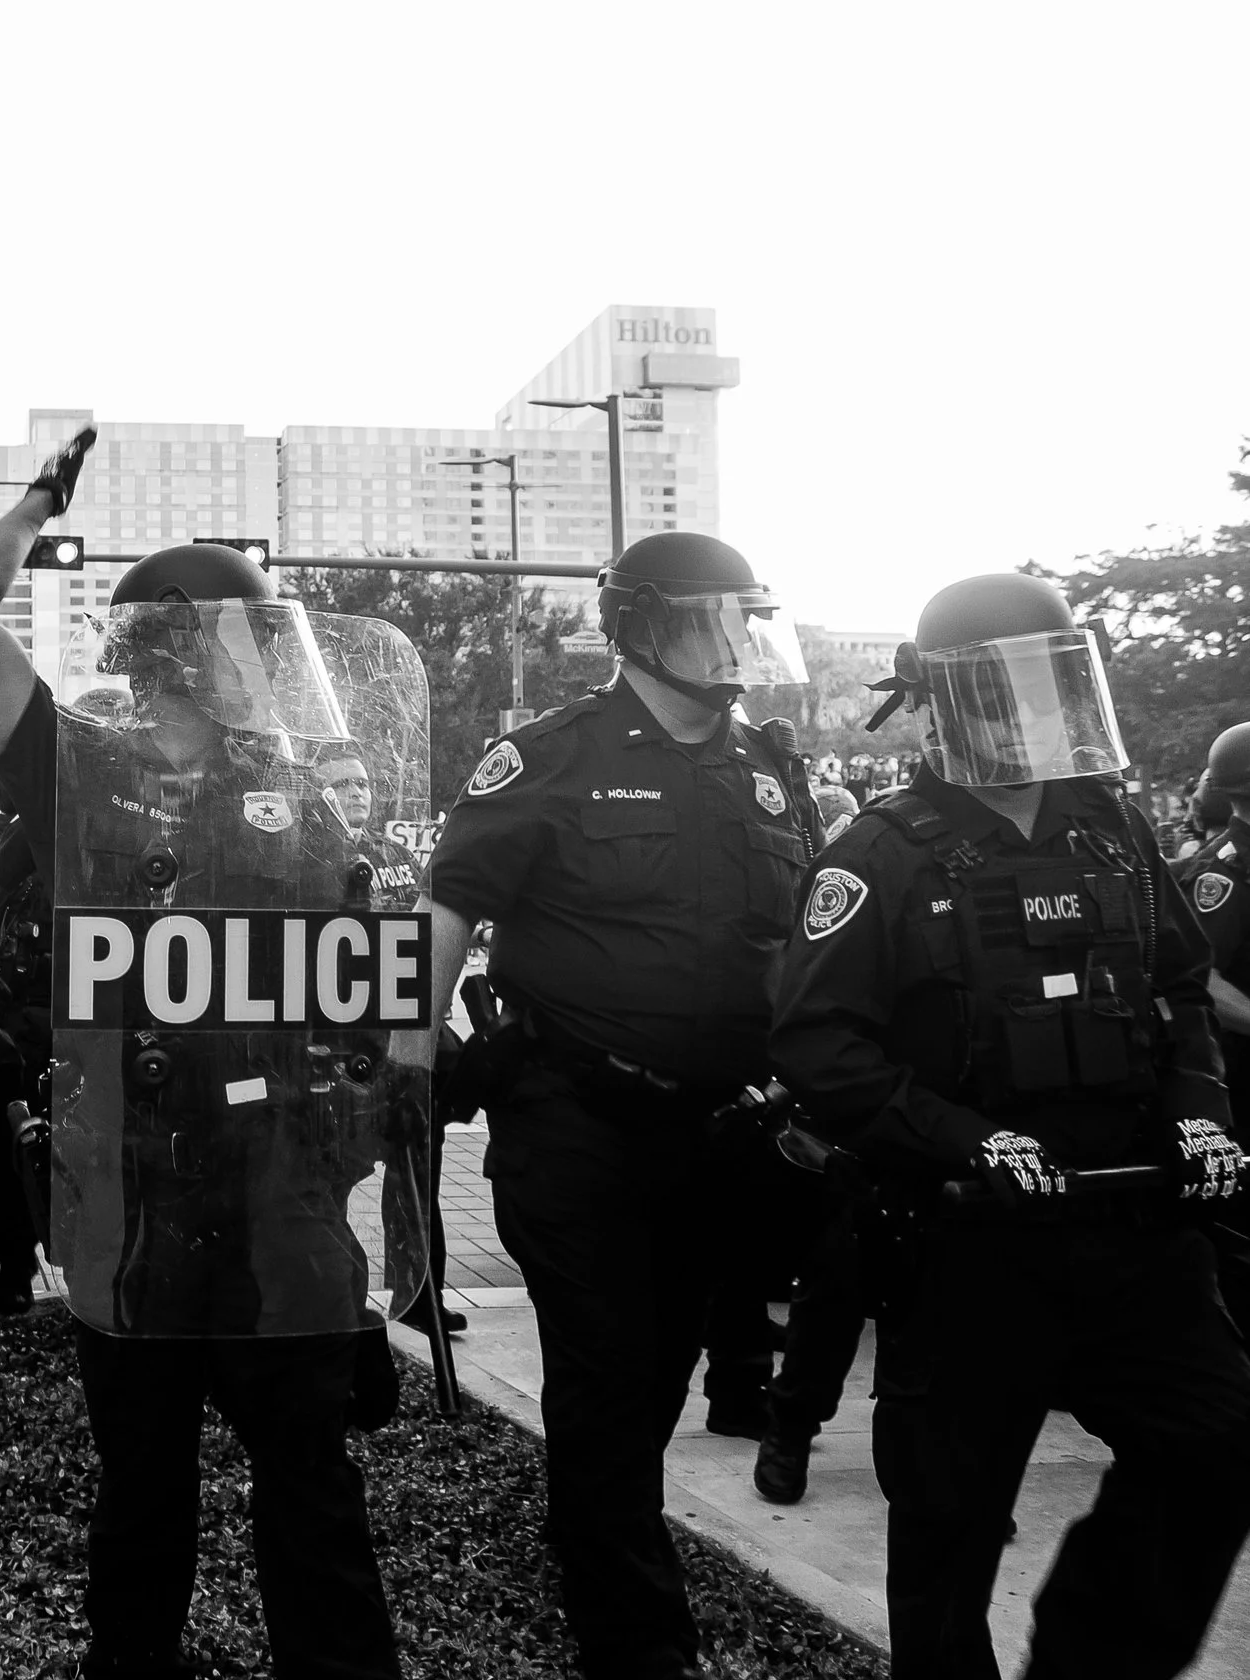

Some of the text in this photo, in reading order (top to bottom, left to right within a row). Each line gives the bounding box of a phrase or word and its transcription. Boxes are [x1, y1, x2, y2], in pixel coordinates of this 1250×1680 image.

[616, 319, 712, 345] Hilton
[111, 794, 145, 814] OLVERA
[608, 788, 662, 800] HOLLOWAY
[378, 864, 416, 889] POLICE
[819, 872, 860, 892] HOUSTON
[1023, 894, 1082, 922] POLICE
[68, 915, 419, 1024] POLICE
